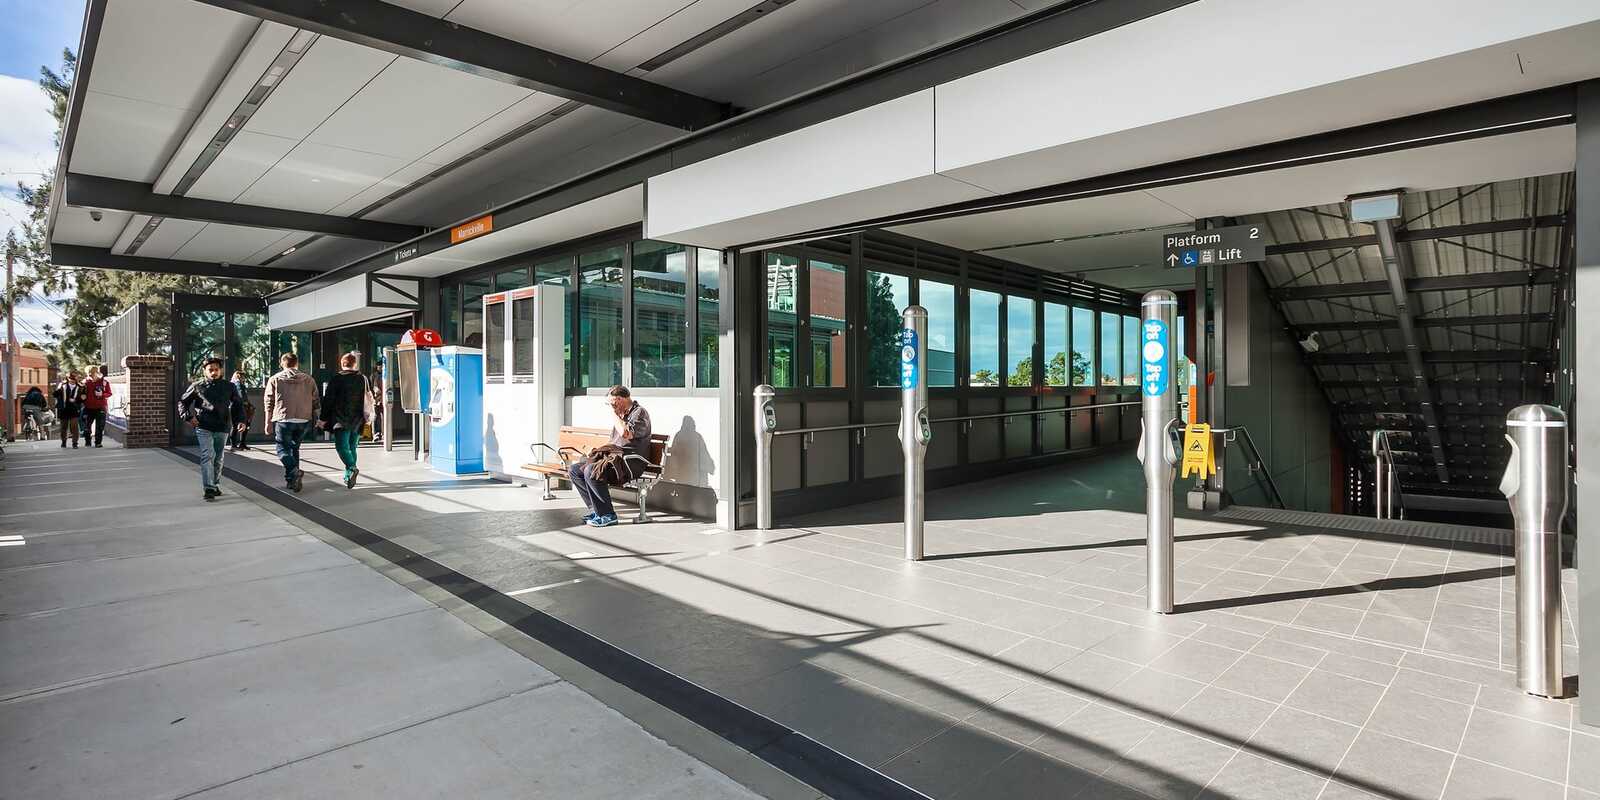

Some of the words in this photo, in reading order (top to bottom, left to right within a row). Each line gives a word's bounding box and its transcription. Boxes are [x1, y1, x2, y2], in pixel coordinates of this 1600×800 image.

[1167, 234, 1220, 248] Platform
[1249, 227, 1259, 239] 2
[1218, 248, 1242, 261] Lift
